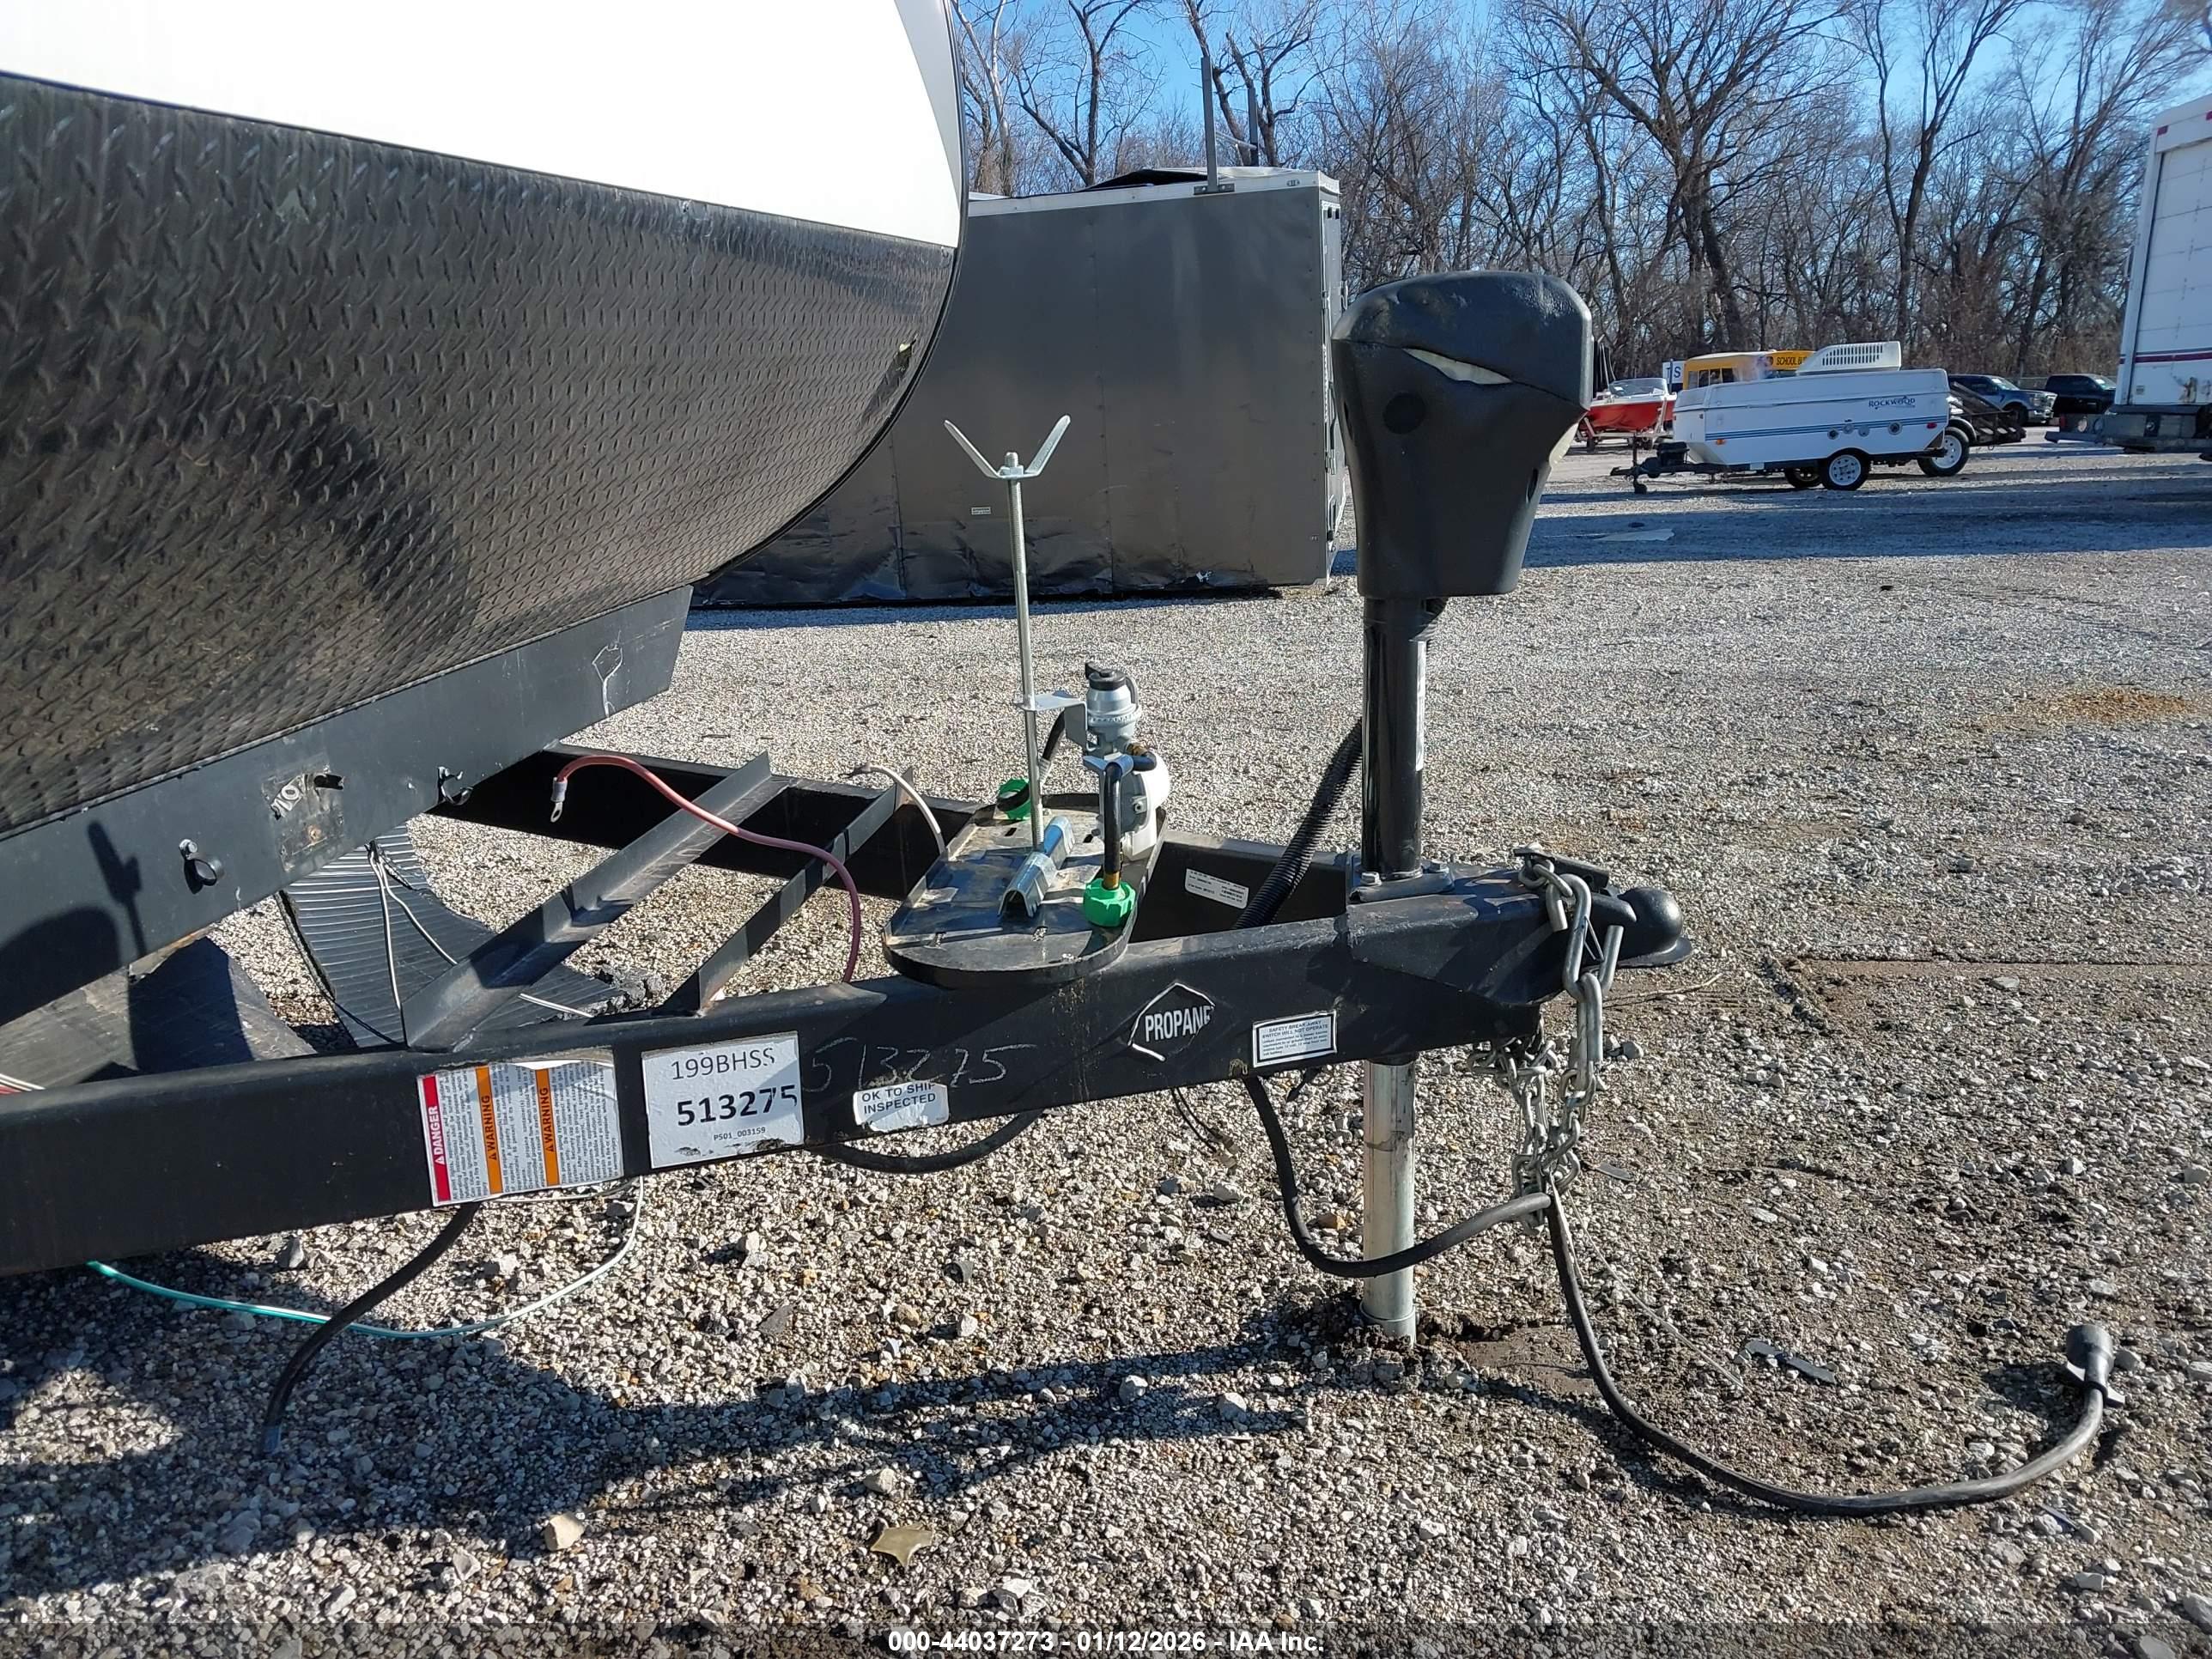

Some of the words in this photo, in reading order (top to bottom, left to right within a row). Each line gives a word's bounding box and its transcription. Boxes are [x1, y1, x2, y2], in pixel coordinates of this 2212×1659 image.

[1777, 357, 1796, 366] SCHOOL
[1869, 398, 1915, 407] ROCKWOOD
[1145, 1005, 1211, 1042] PROPANE
[671, 1048, 775, 1080] 199BHSS
[802, 1036, 1037, 1093] 513275
[677, 1085, 797, 1127] 513275
[862, 1091, 880, 1103] OK
[885, 1087, 902, 1098] TO
[864, 1092, 936, 1115] INSPECTED
[428, 1105, 444, 1155] DANGER
[481, 1095, 496, 1151] WARNING
[538, 1087, 553, 1142] WARNING
